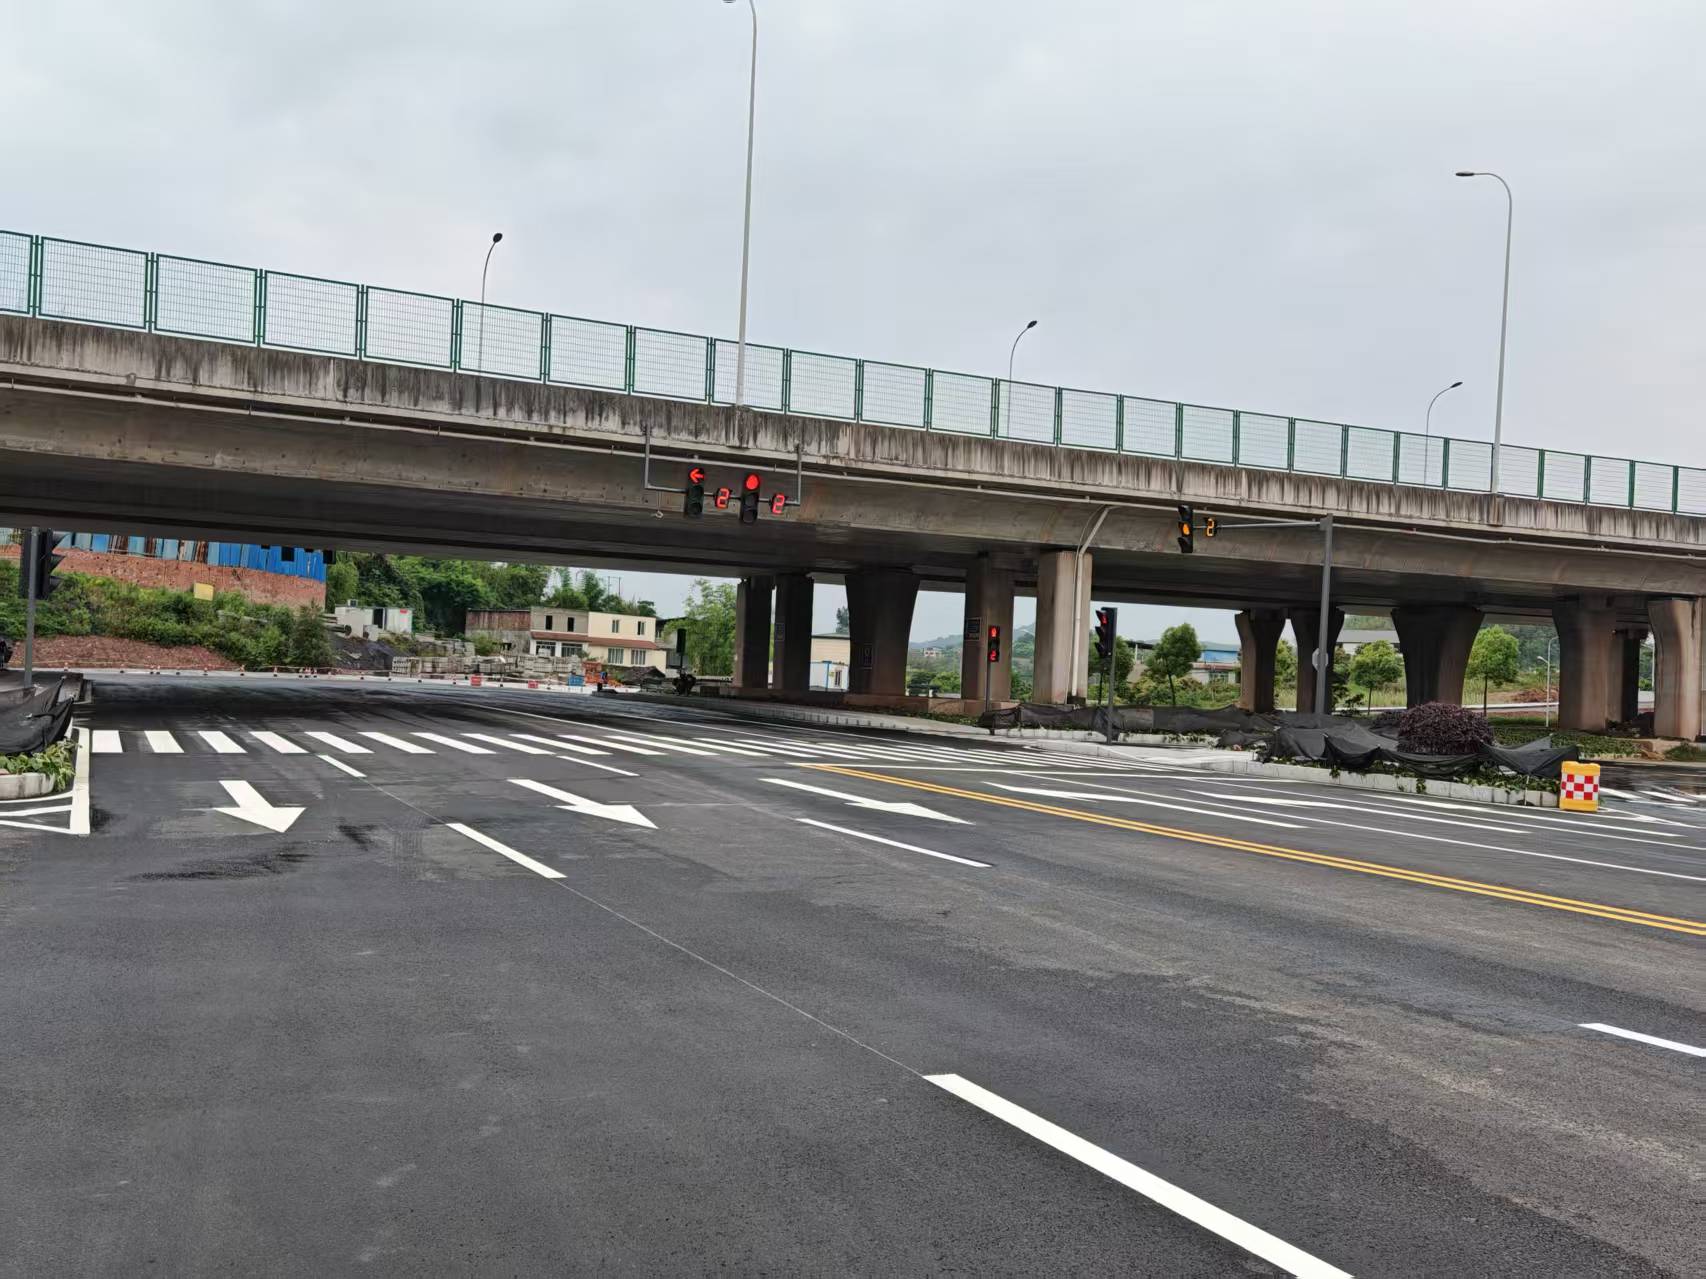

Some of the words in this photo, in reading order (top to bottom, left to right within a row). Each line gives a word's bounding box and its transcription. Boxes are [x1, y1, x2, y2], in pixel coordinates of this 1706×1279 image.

[716, 488, 729, 509] 2
[772, 494, 785, 514] 2
[1206, 518, 1215, 537] 2
